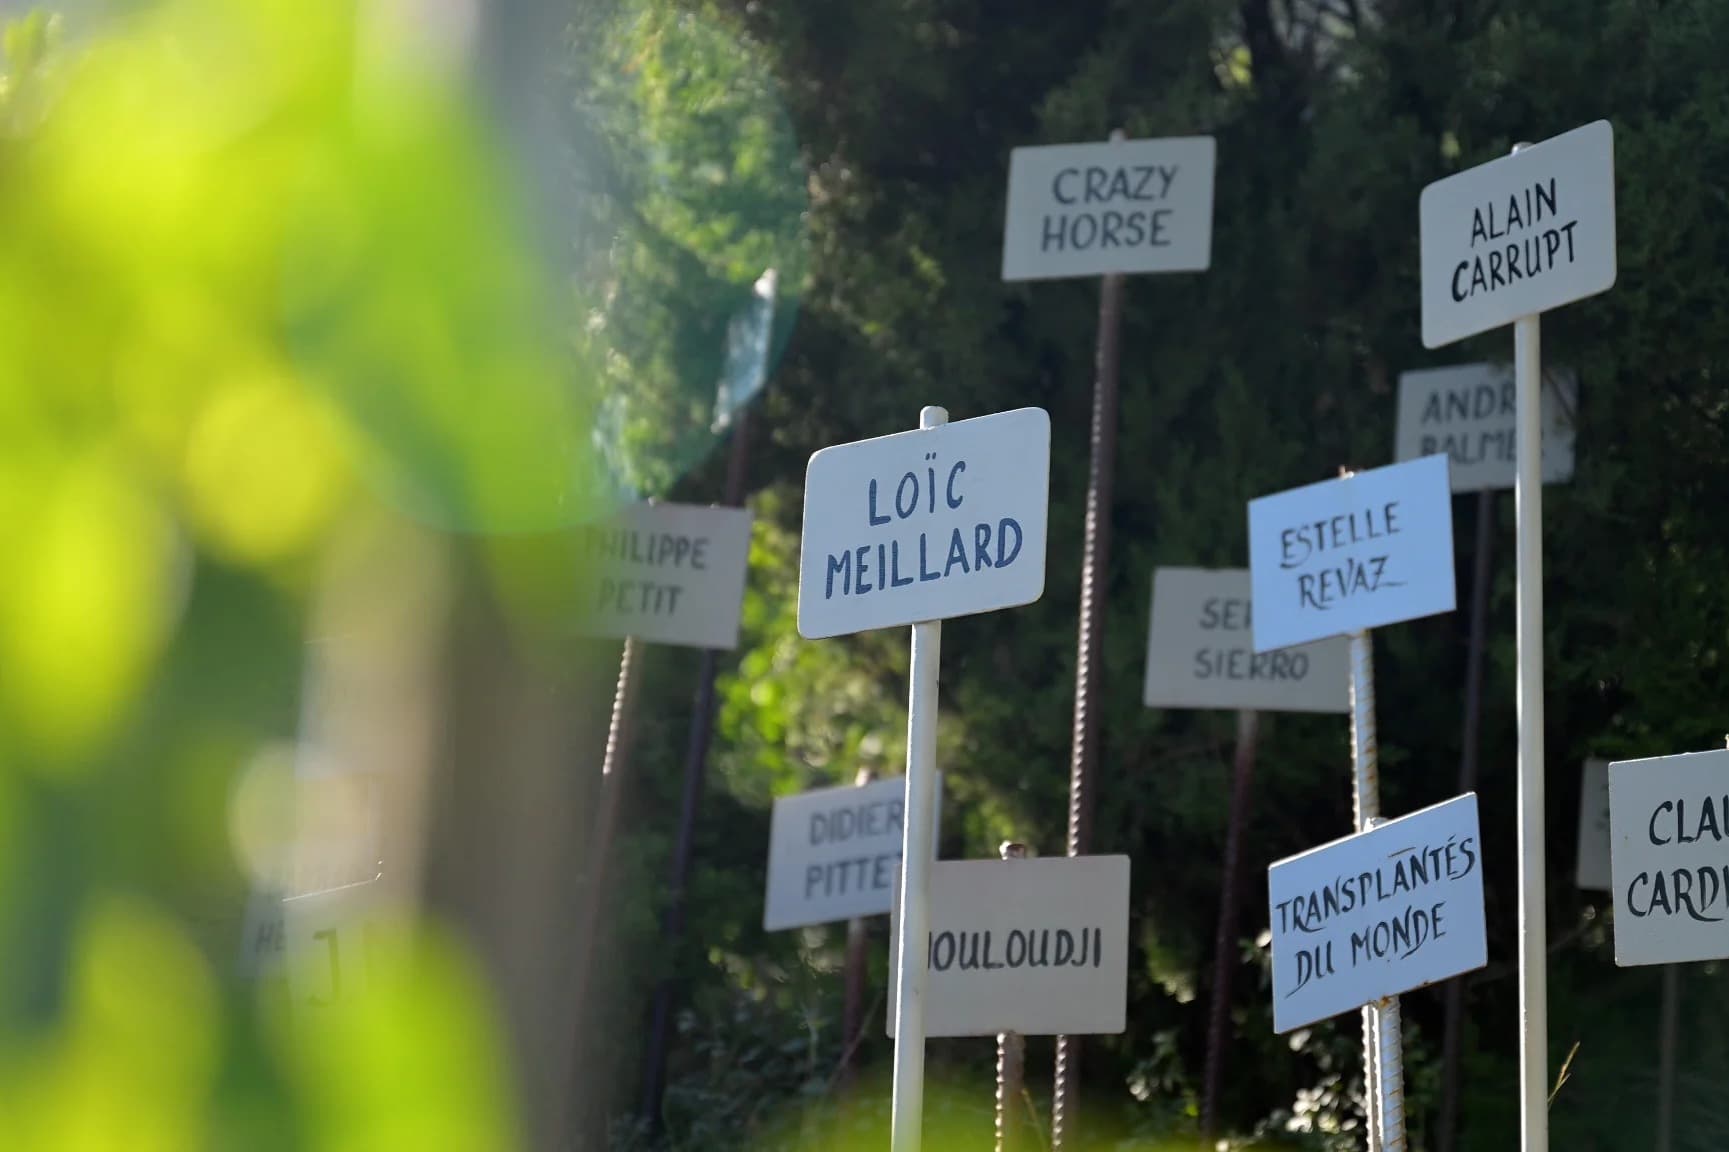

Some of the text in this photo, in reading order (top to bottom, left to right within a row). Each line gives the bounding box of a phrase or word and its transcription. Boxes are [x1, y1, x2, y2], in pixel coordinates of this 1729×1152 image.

[1053, 164, 1180, 204] CRAZY
[1041, 208, 1173, 252] HORSE
[1470, 178, 1557, 248] ALAIN
[1452, 220, 1578, 302] CARRUPT
[1421, 383, 1516, 424] ANDR
[869, 452, 966, 526] LOÏC
[825, 518, 1023, 600] MEILLARD
[1280, 502, 1401, 569] ESTELLE
[1298, 556, 1407, 611] REVAZ
[1194, 648, 1310, 680] SIERRO
[810, 799, 904, 846] DIDIER
[1649, 795, 1729, 845] CLA
[804, 852, 903, 899] PITTE
[1276, 834, 1476, 935] TRANSPLANTÉS
[928, 928, 1101, 971] OULOUDJI
[1284, 901, 1448, 998] DU MONDE
